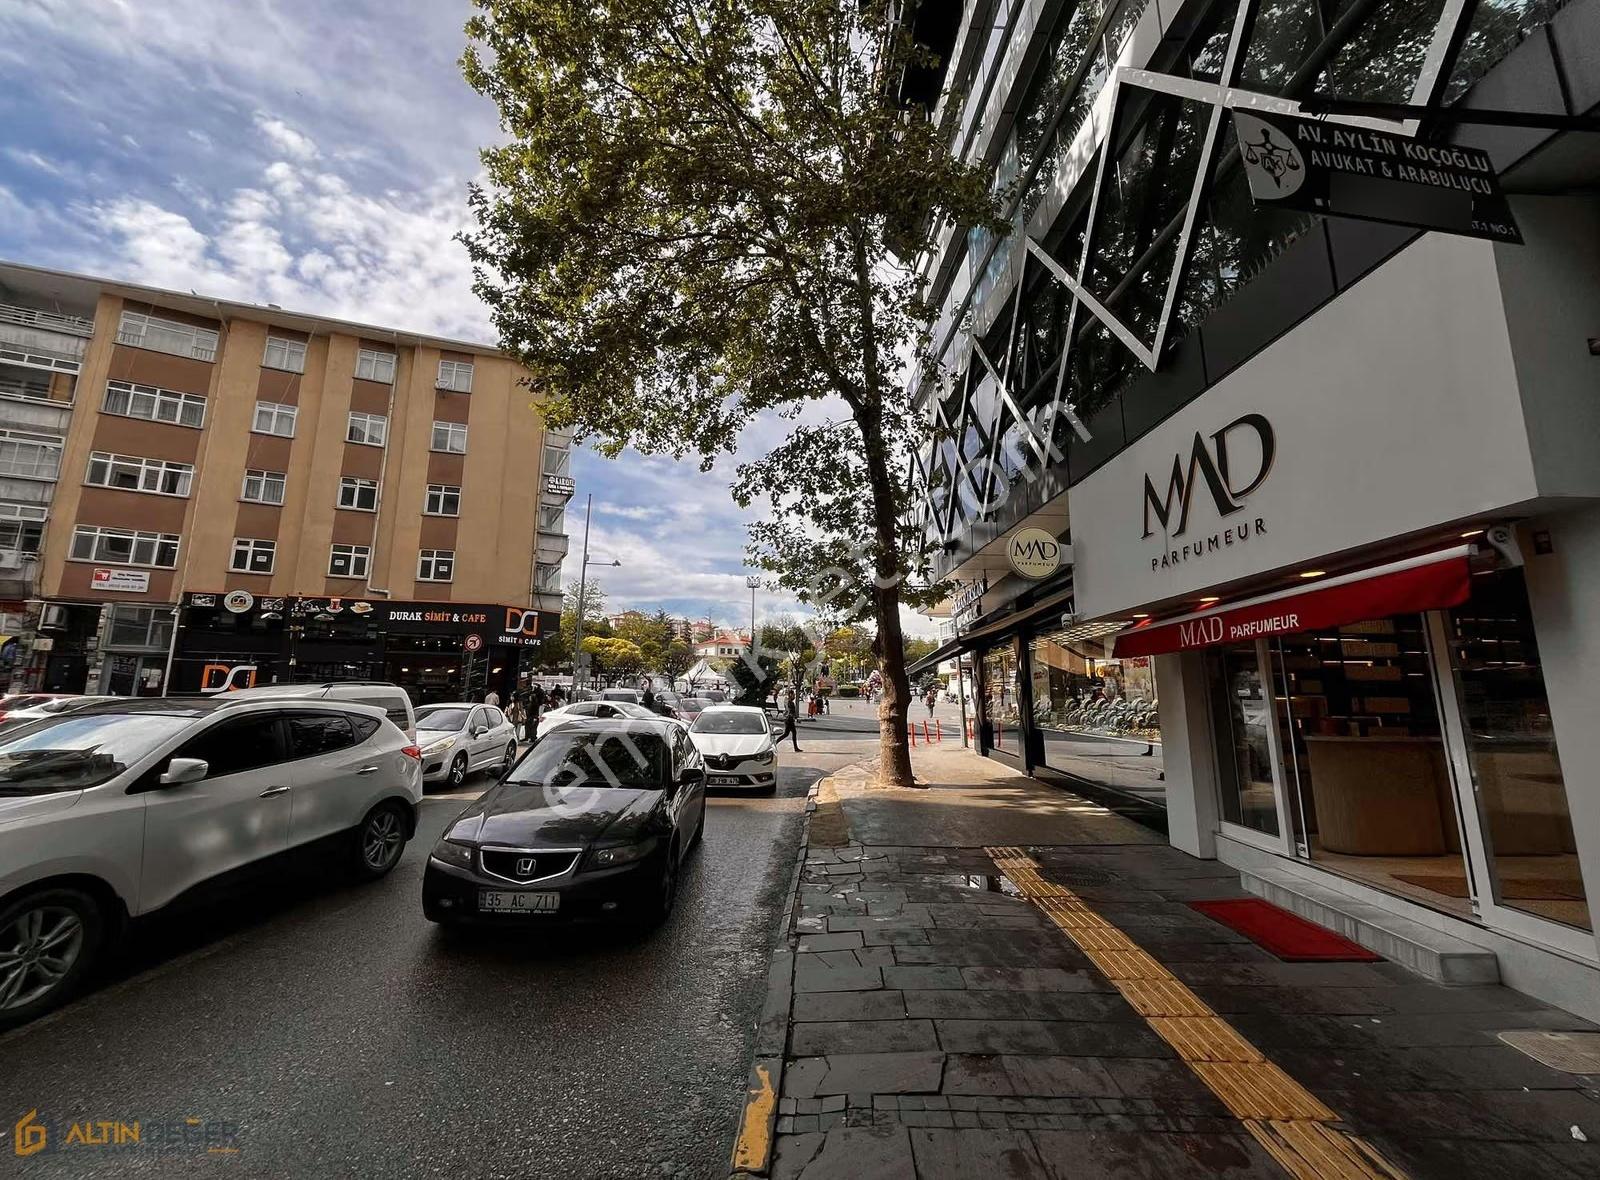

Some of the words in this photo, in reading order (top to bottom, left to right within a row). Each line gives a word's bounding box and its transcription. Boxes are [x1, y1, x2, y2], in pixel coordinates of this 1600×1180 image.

[1298, 124, 1328, 144] AV.
[1334, 130, 1396, 155] AYLİN
[1402, 138, 1489, 172] KOÇOĞLU
[1311, 151, 1374, 175] AVUKAT
[1381, 161, 1393, 178] &
[1399, 164, 1492, 195] ARABULUCU
[1141, 413, 1275, 540] MAD
[1014, 539, 1057, 560] MAD
[1152, 518, 1267, 571] PARFUMEUR
[389, 611, 423, 621] DURAK
[424, 611, 450, 622] SİMİT
[452, 614, 460, 622] &
[461, 614, 487, 623] CAFE
[1180, 616, 1224, 647] MAD
[1230, 614, 1300, 638] PARFUMEUR
[524, 638, 541, 646] CAFE
[487, 893, 503, 906] 35
[511, 894, 525, 907] AC
